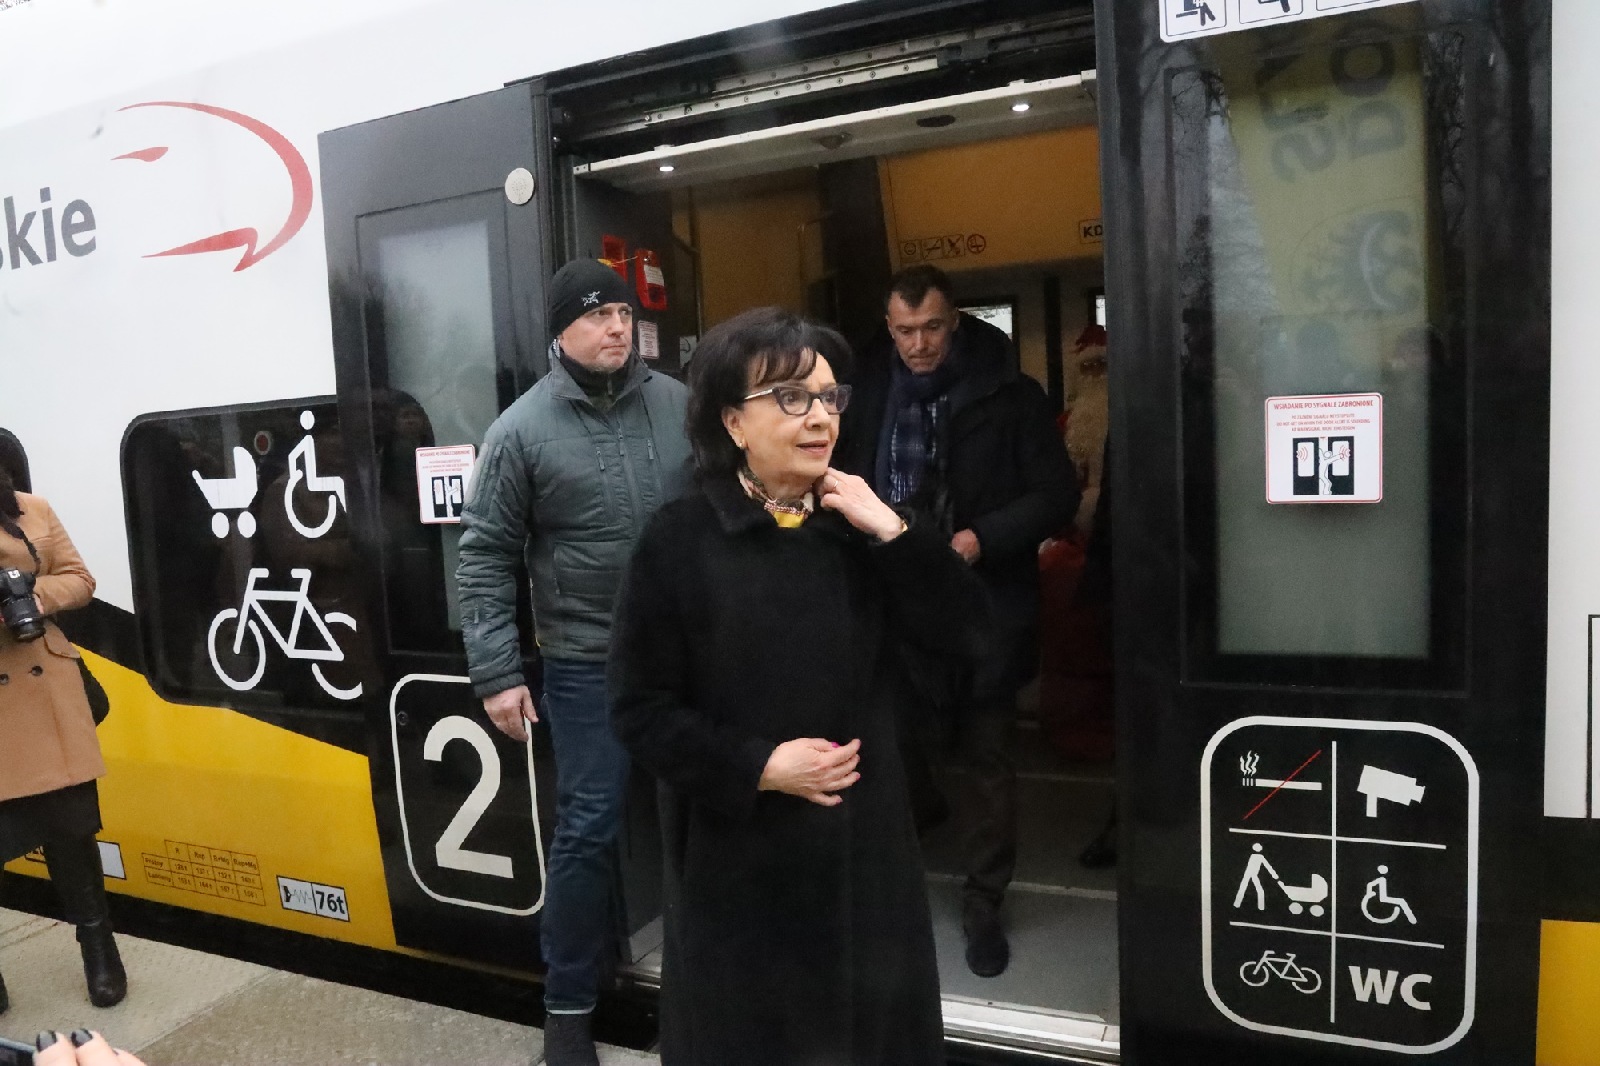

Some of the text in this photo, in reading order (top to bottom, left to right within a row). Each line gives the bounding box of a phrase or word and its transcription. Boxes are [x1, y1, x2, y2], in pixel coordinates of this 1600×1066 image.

[0, 187, 97, 270] kie
[423, 715, 514, 879] 2
[315, 890, 346, 914] 76t
[1348, 965, 1433, 1011] WC
